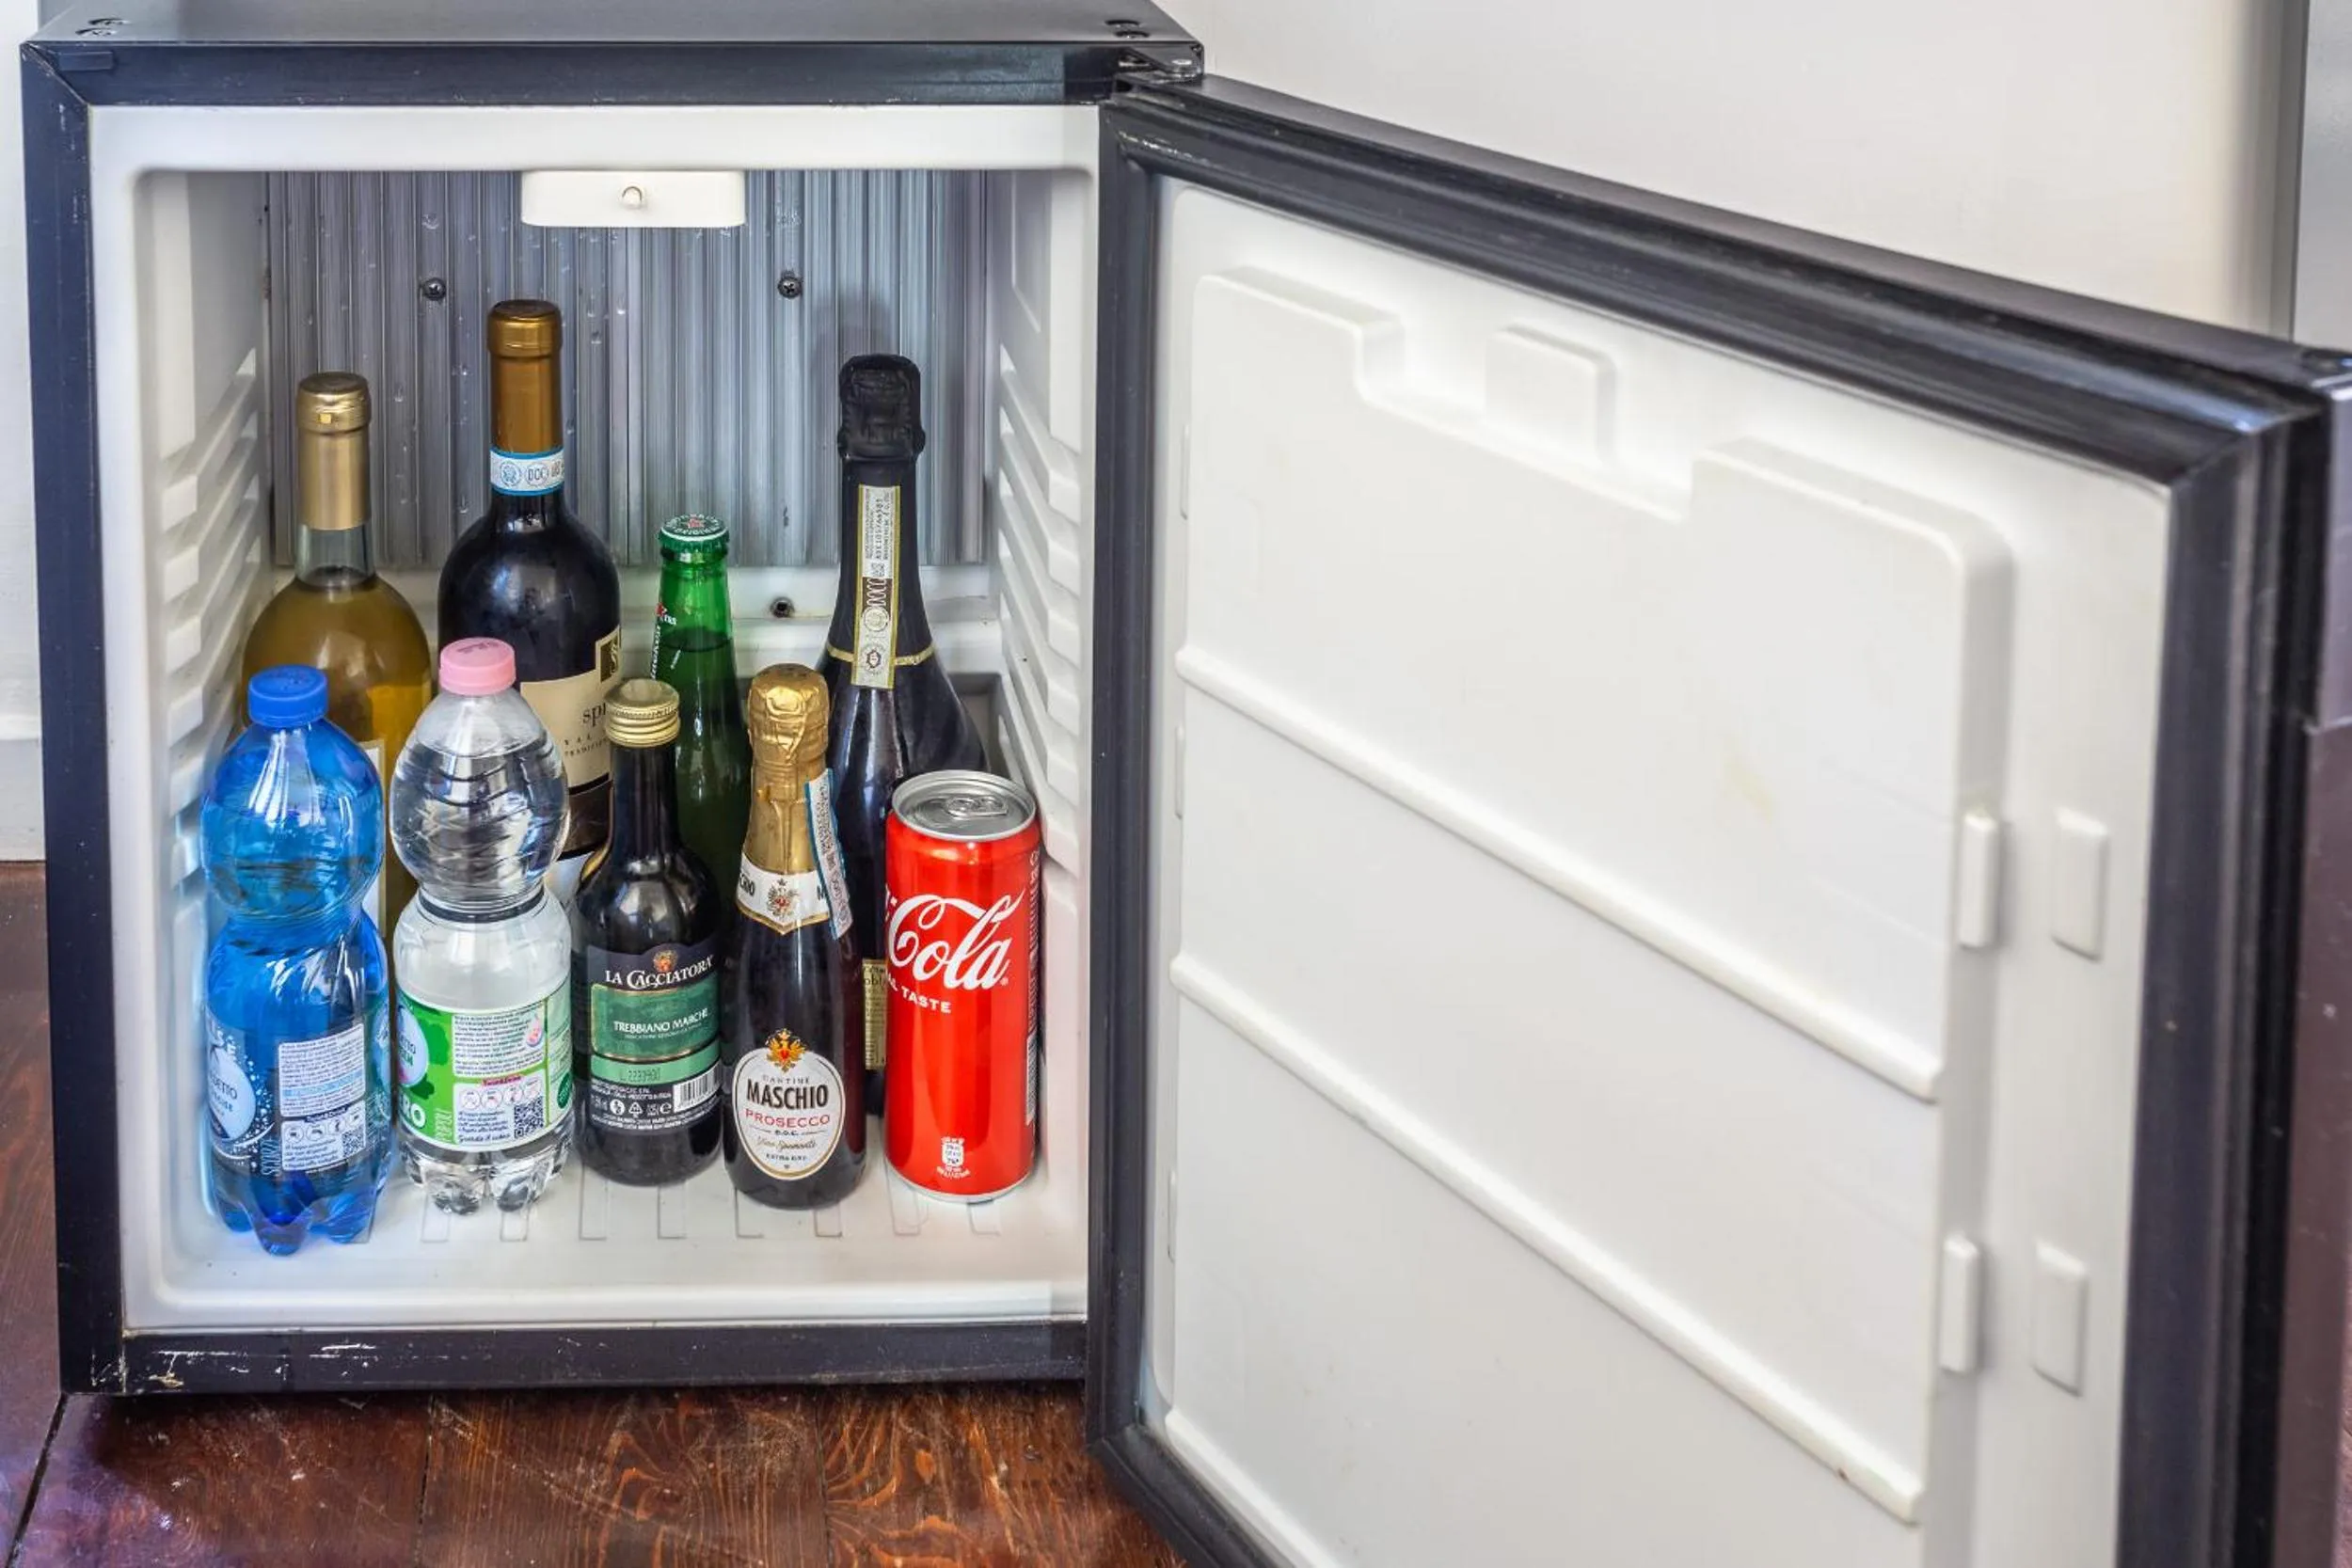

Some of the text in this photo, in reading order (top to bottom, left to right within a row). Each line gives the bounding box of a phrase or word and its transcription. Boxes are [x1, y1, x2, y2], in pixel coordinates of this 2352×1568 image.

[605, 969, 624, 986] LA
[900, 985, 952, 1014] TASTE
[613, 1020, 671, 1034] TREBBIANO
[672, 1007, 708, 1030] MARCHE
[762, 1073, 811, 1085] CANTINE
[747, 1078, 829, 1110] MASCHIO
[745, 1108, 831, 1128] PROSECCO
